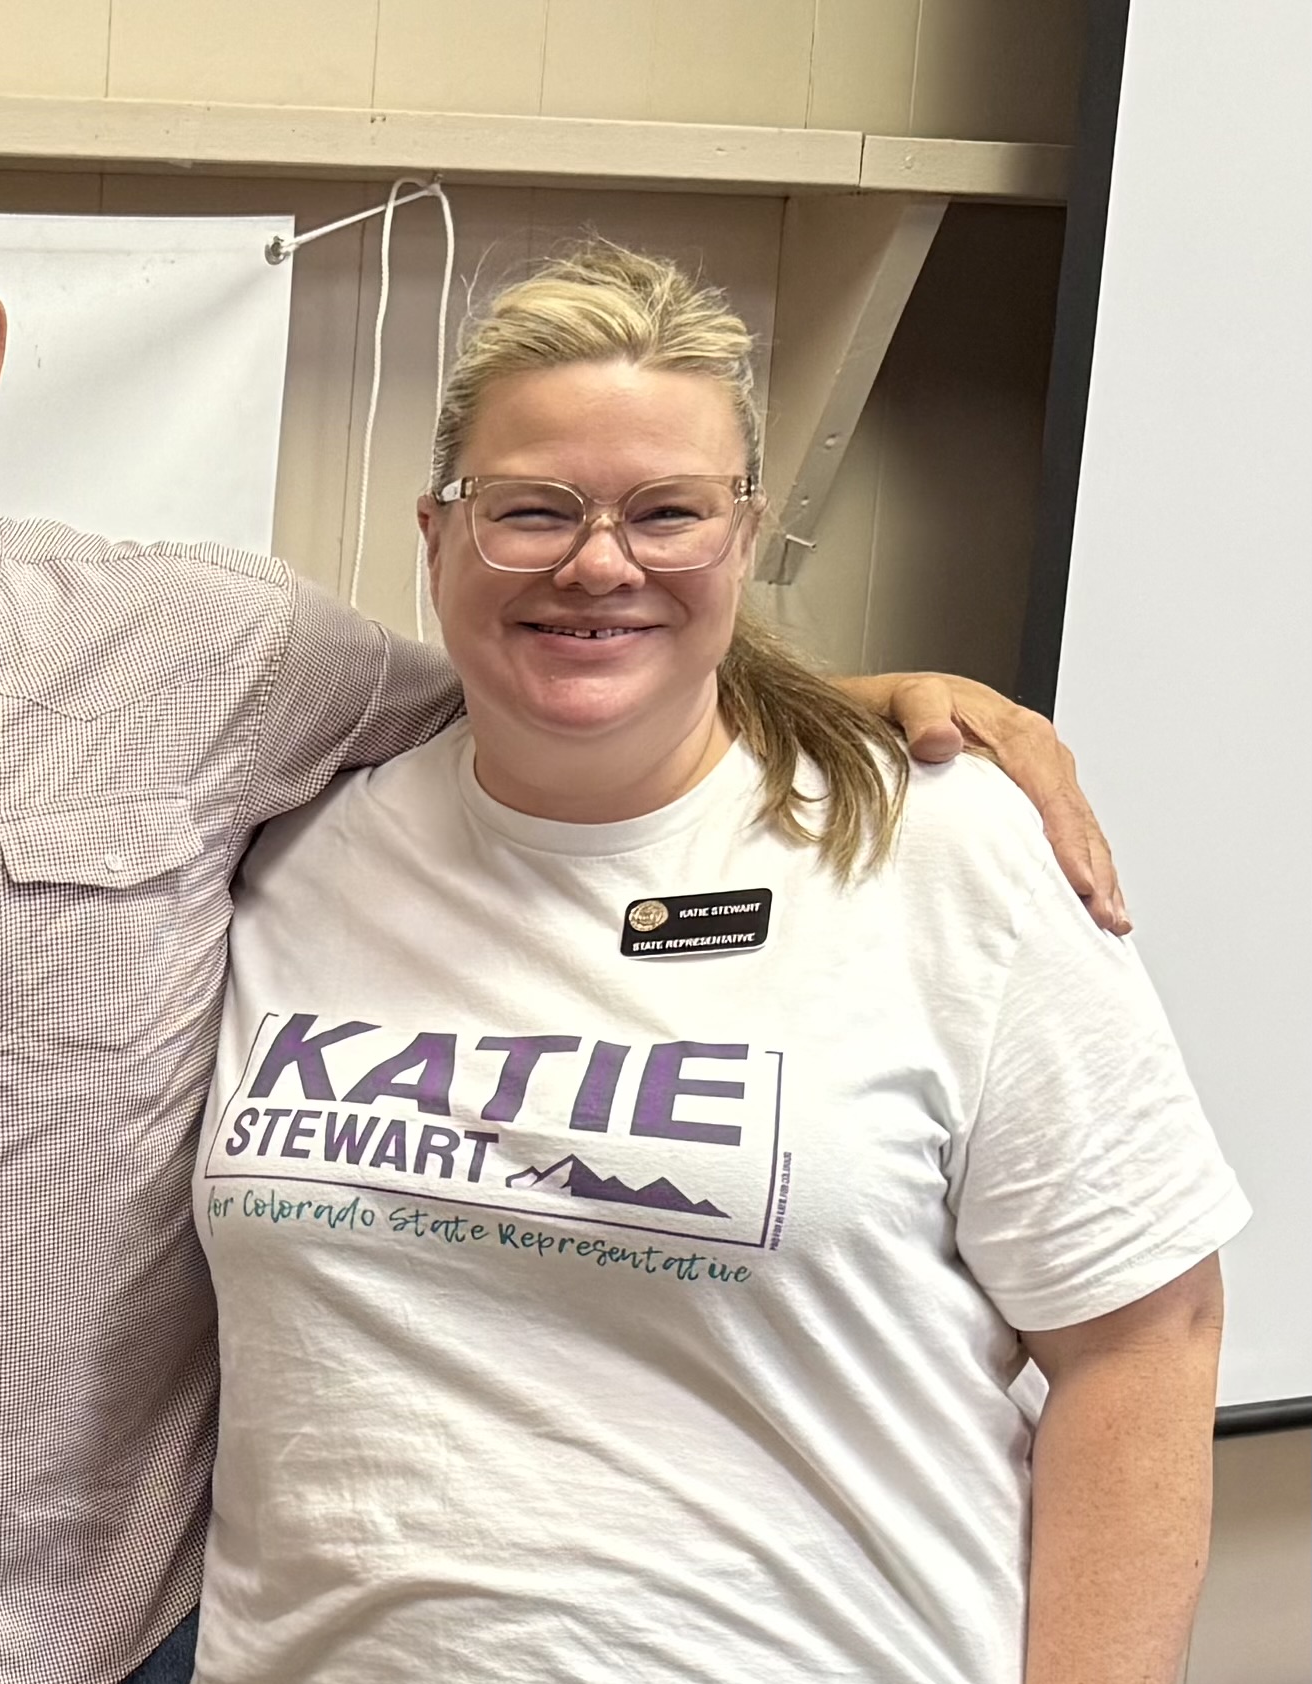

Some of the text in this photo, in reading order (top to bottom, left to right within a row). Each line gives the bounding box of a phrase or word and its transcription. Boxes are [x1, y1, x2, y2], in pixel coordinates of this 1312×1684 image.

[711, 903, 762, 916] STEWART
[247, 1013, 750, 1146] KATIE
[226, 1107, 500, 1184] STEWART
[243, 1188, 375, 1230] Colorado
[389, 1207, 491, 1243] State
[499, 1223, 753, 1283] Representative
